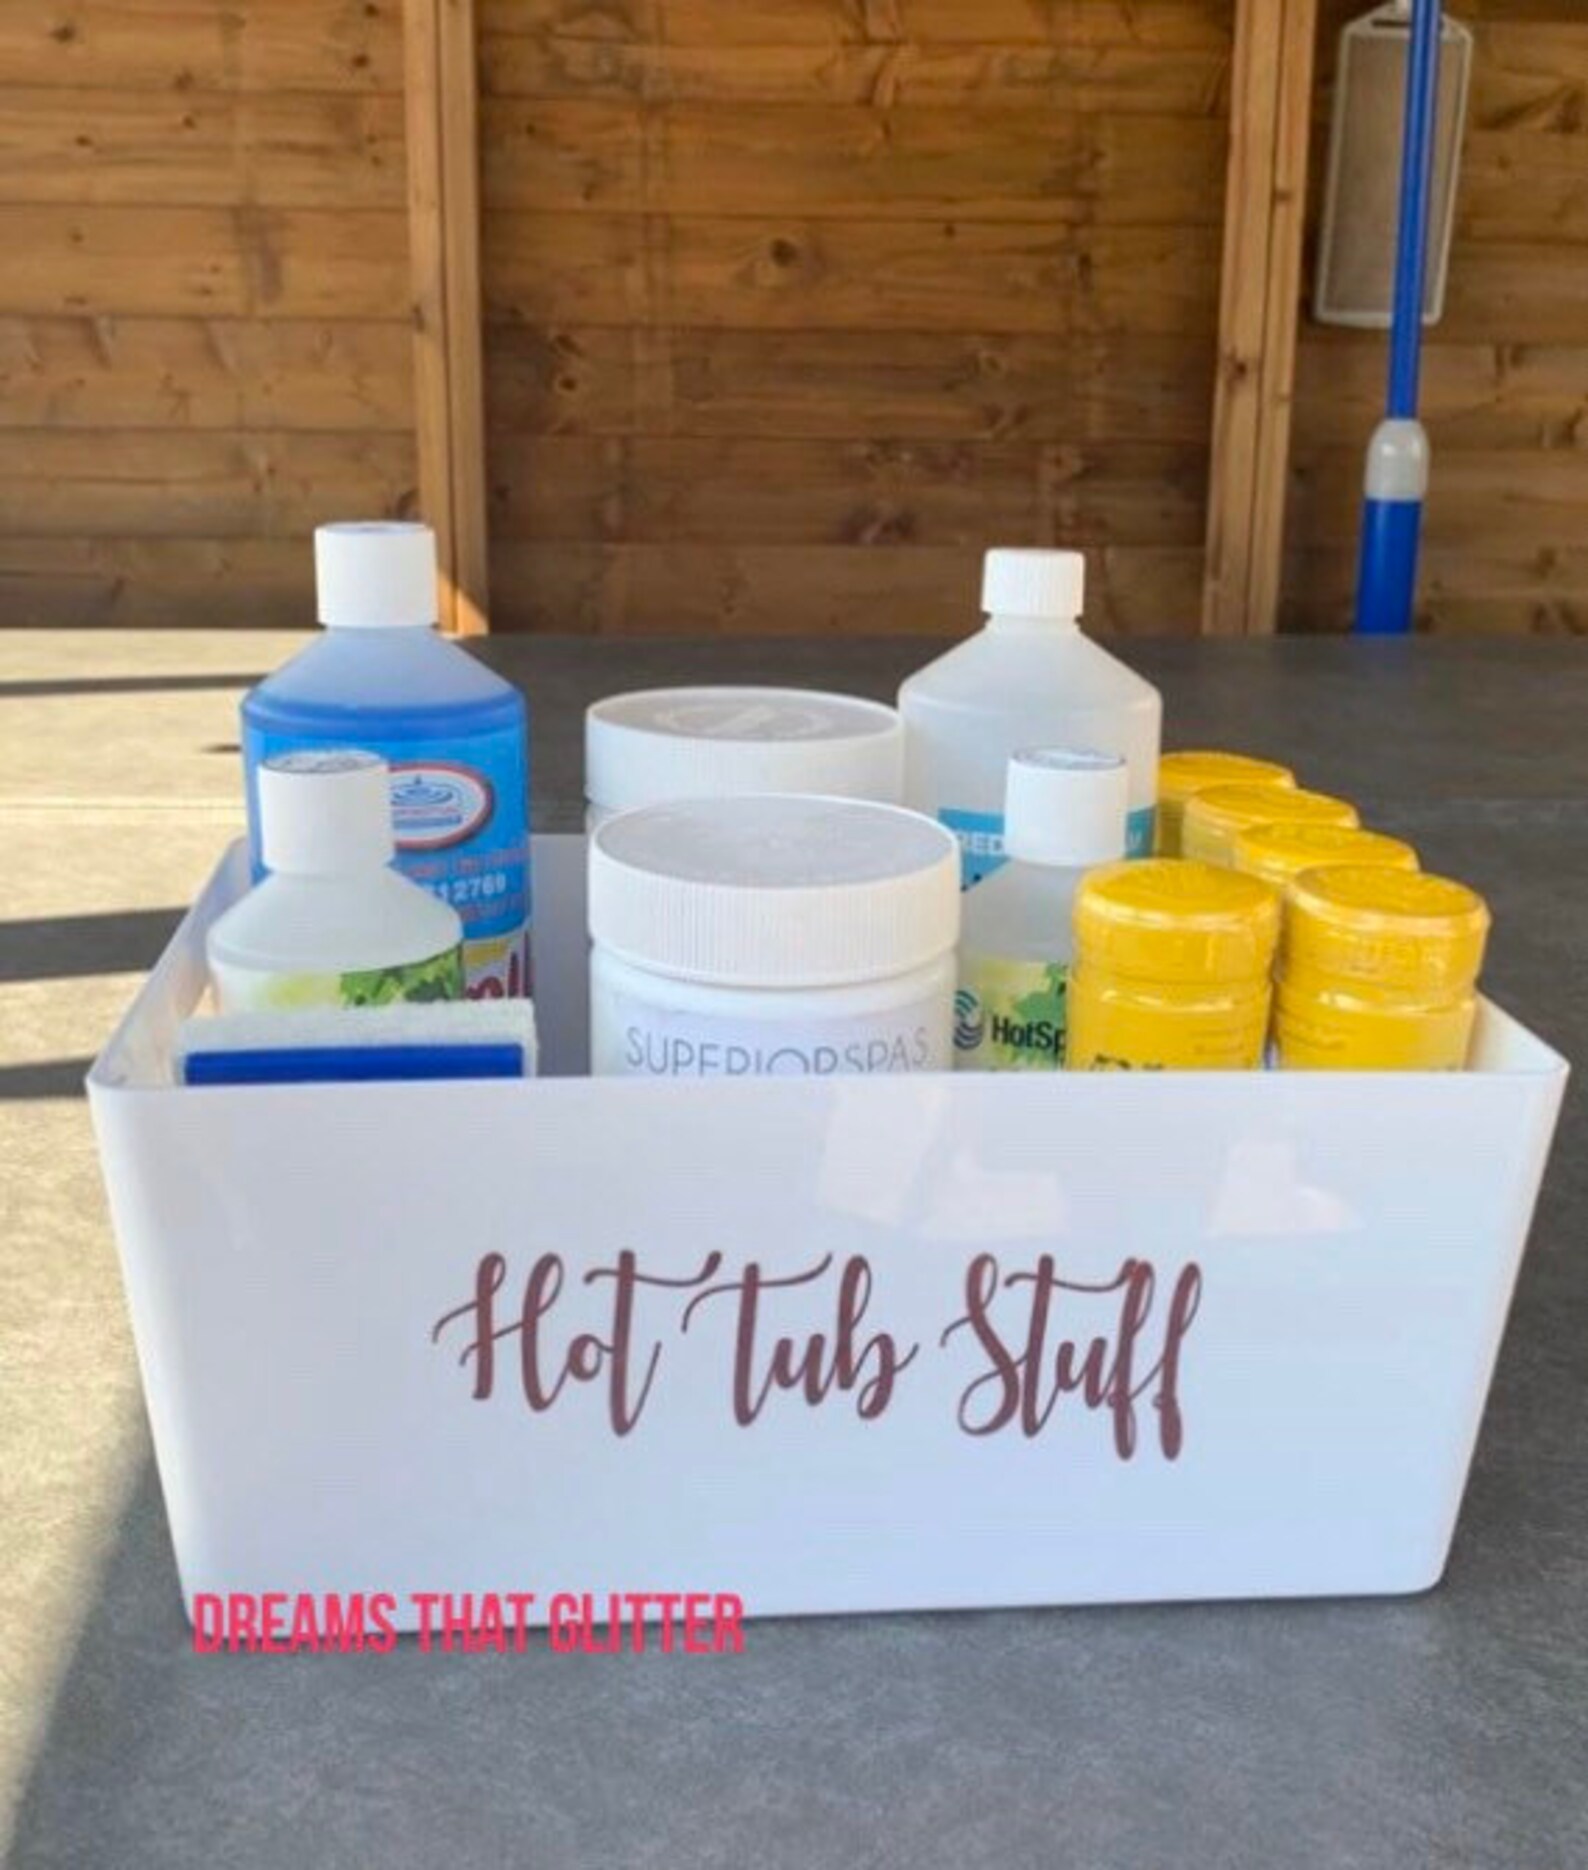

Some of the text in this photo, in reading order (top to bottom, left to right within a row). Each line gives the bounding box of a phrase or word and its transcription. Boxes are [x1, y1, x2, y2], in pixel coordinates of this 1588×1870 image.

[432, 1249, 1201, 1460] Hot Tub Stuff
